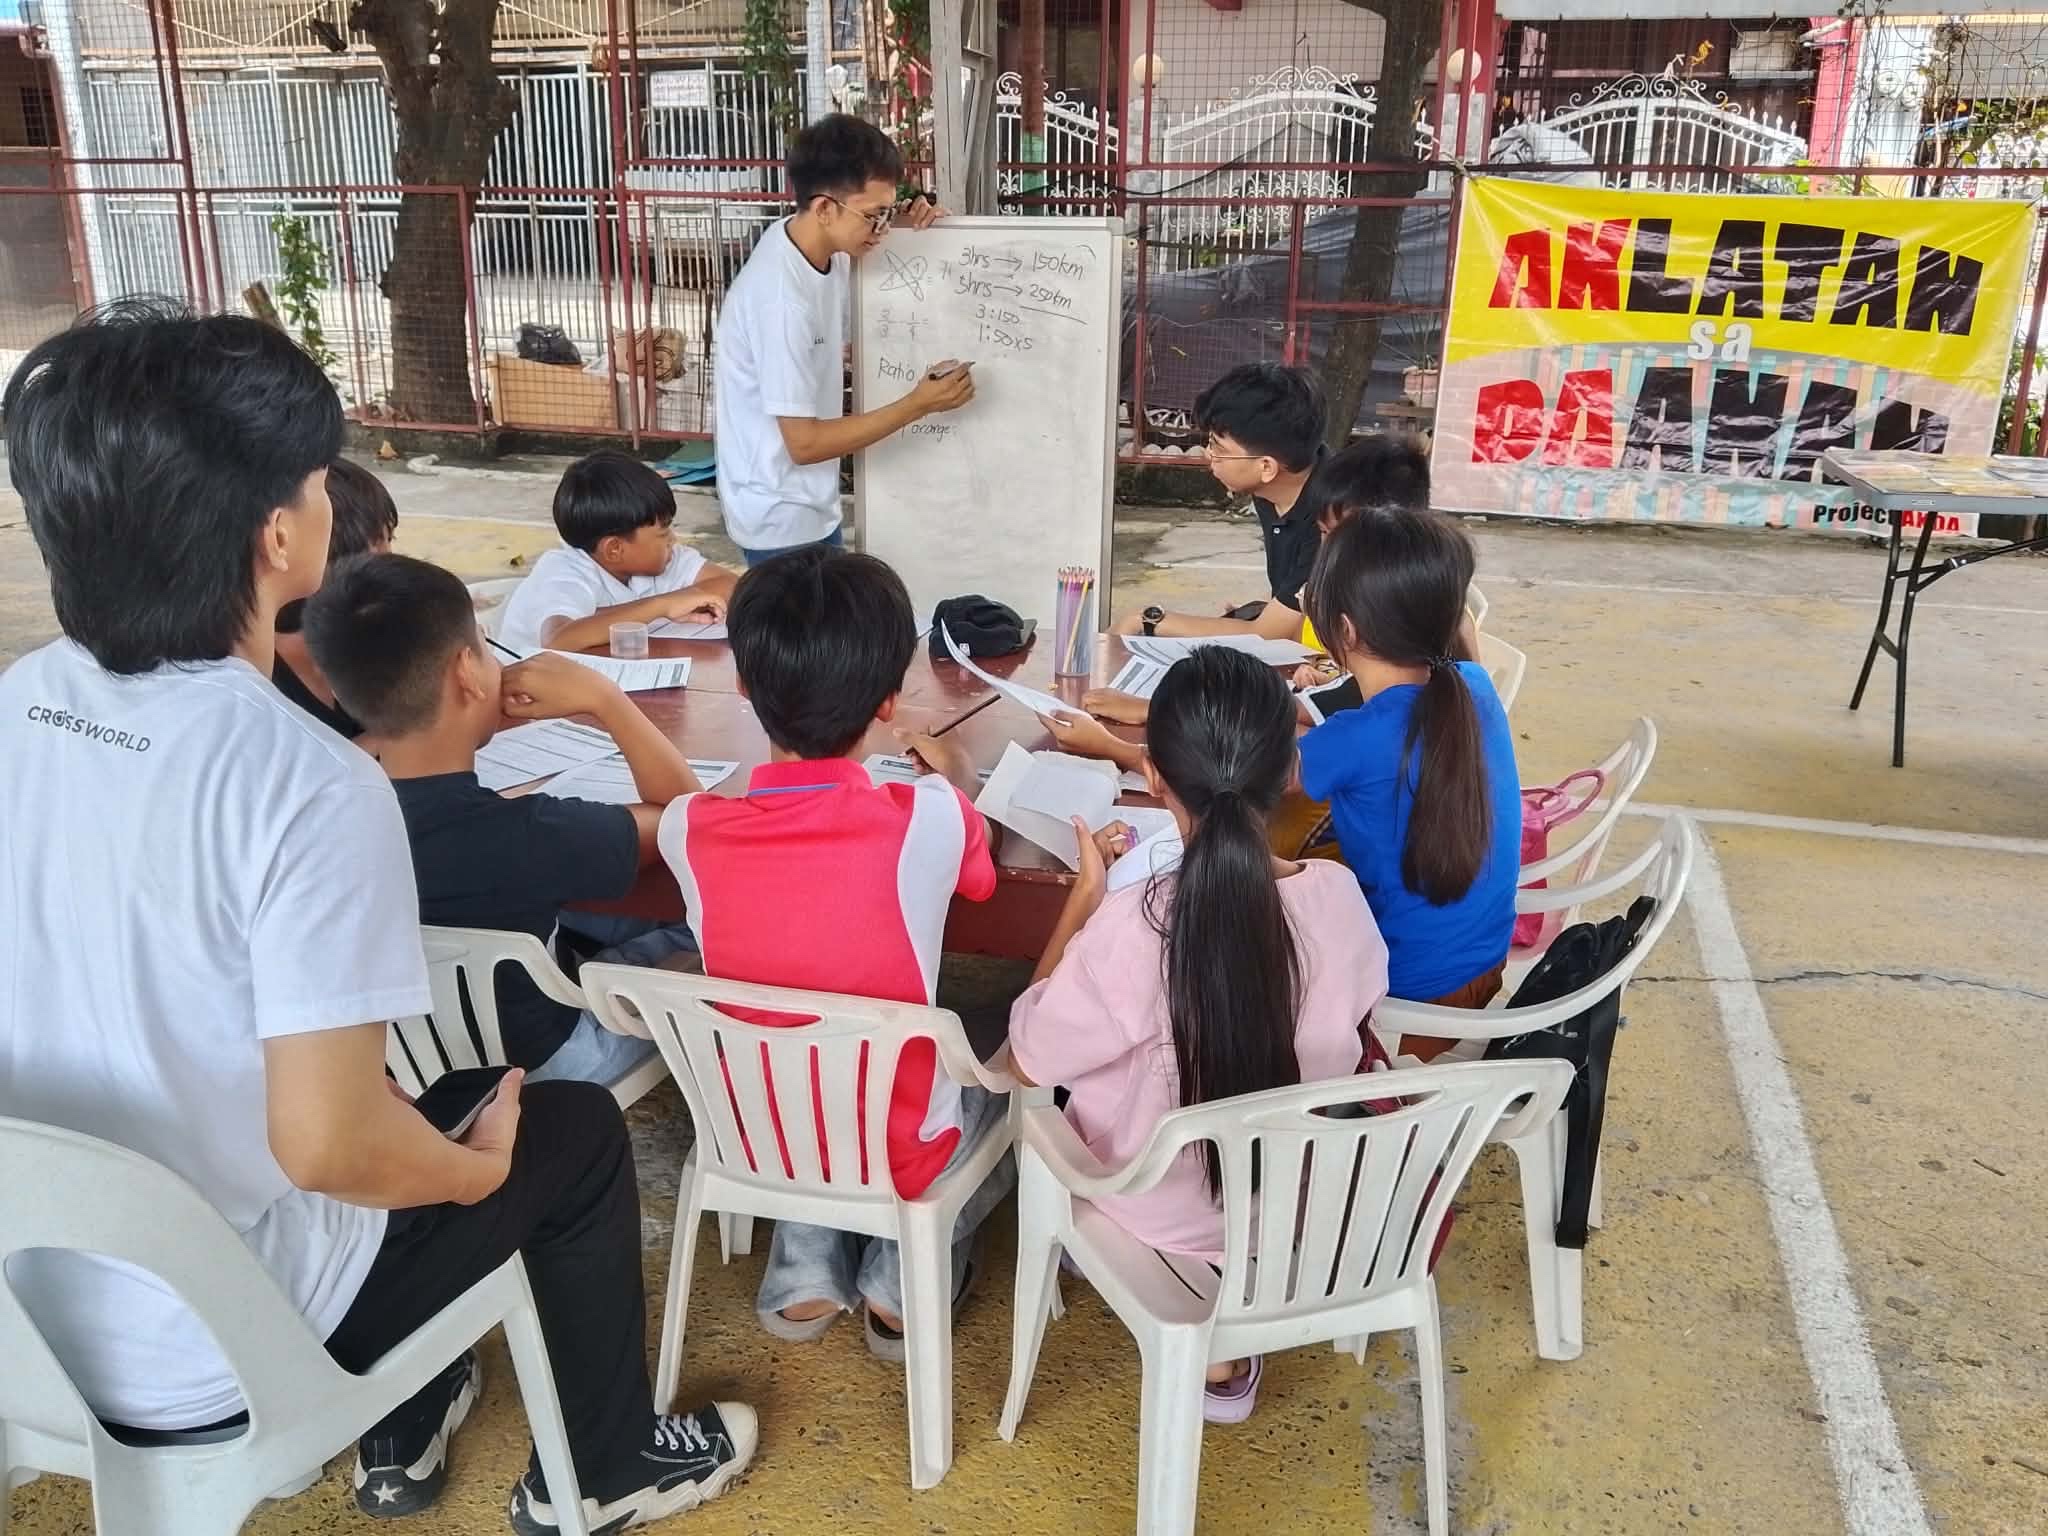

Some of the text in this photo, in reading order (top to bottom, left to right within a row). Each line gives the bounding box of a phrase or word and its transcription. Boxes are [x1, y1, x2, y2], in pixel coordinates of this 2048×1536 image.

[1489, 217, 1985, 337] AKLATAN
[1687, 320, 1753, 363] sa
[27, 705, 151, 752] CROSSWORLD
